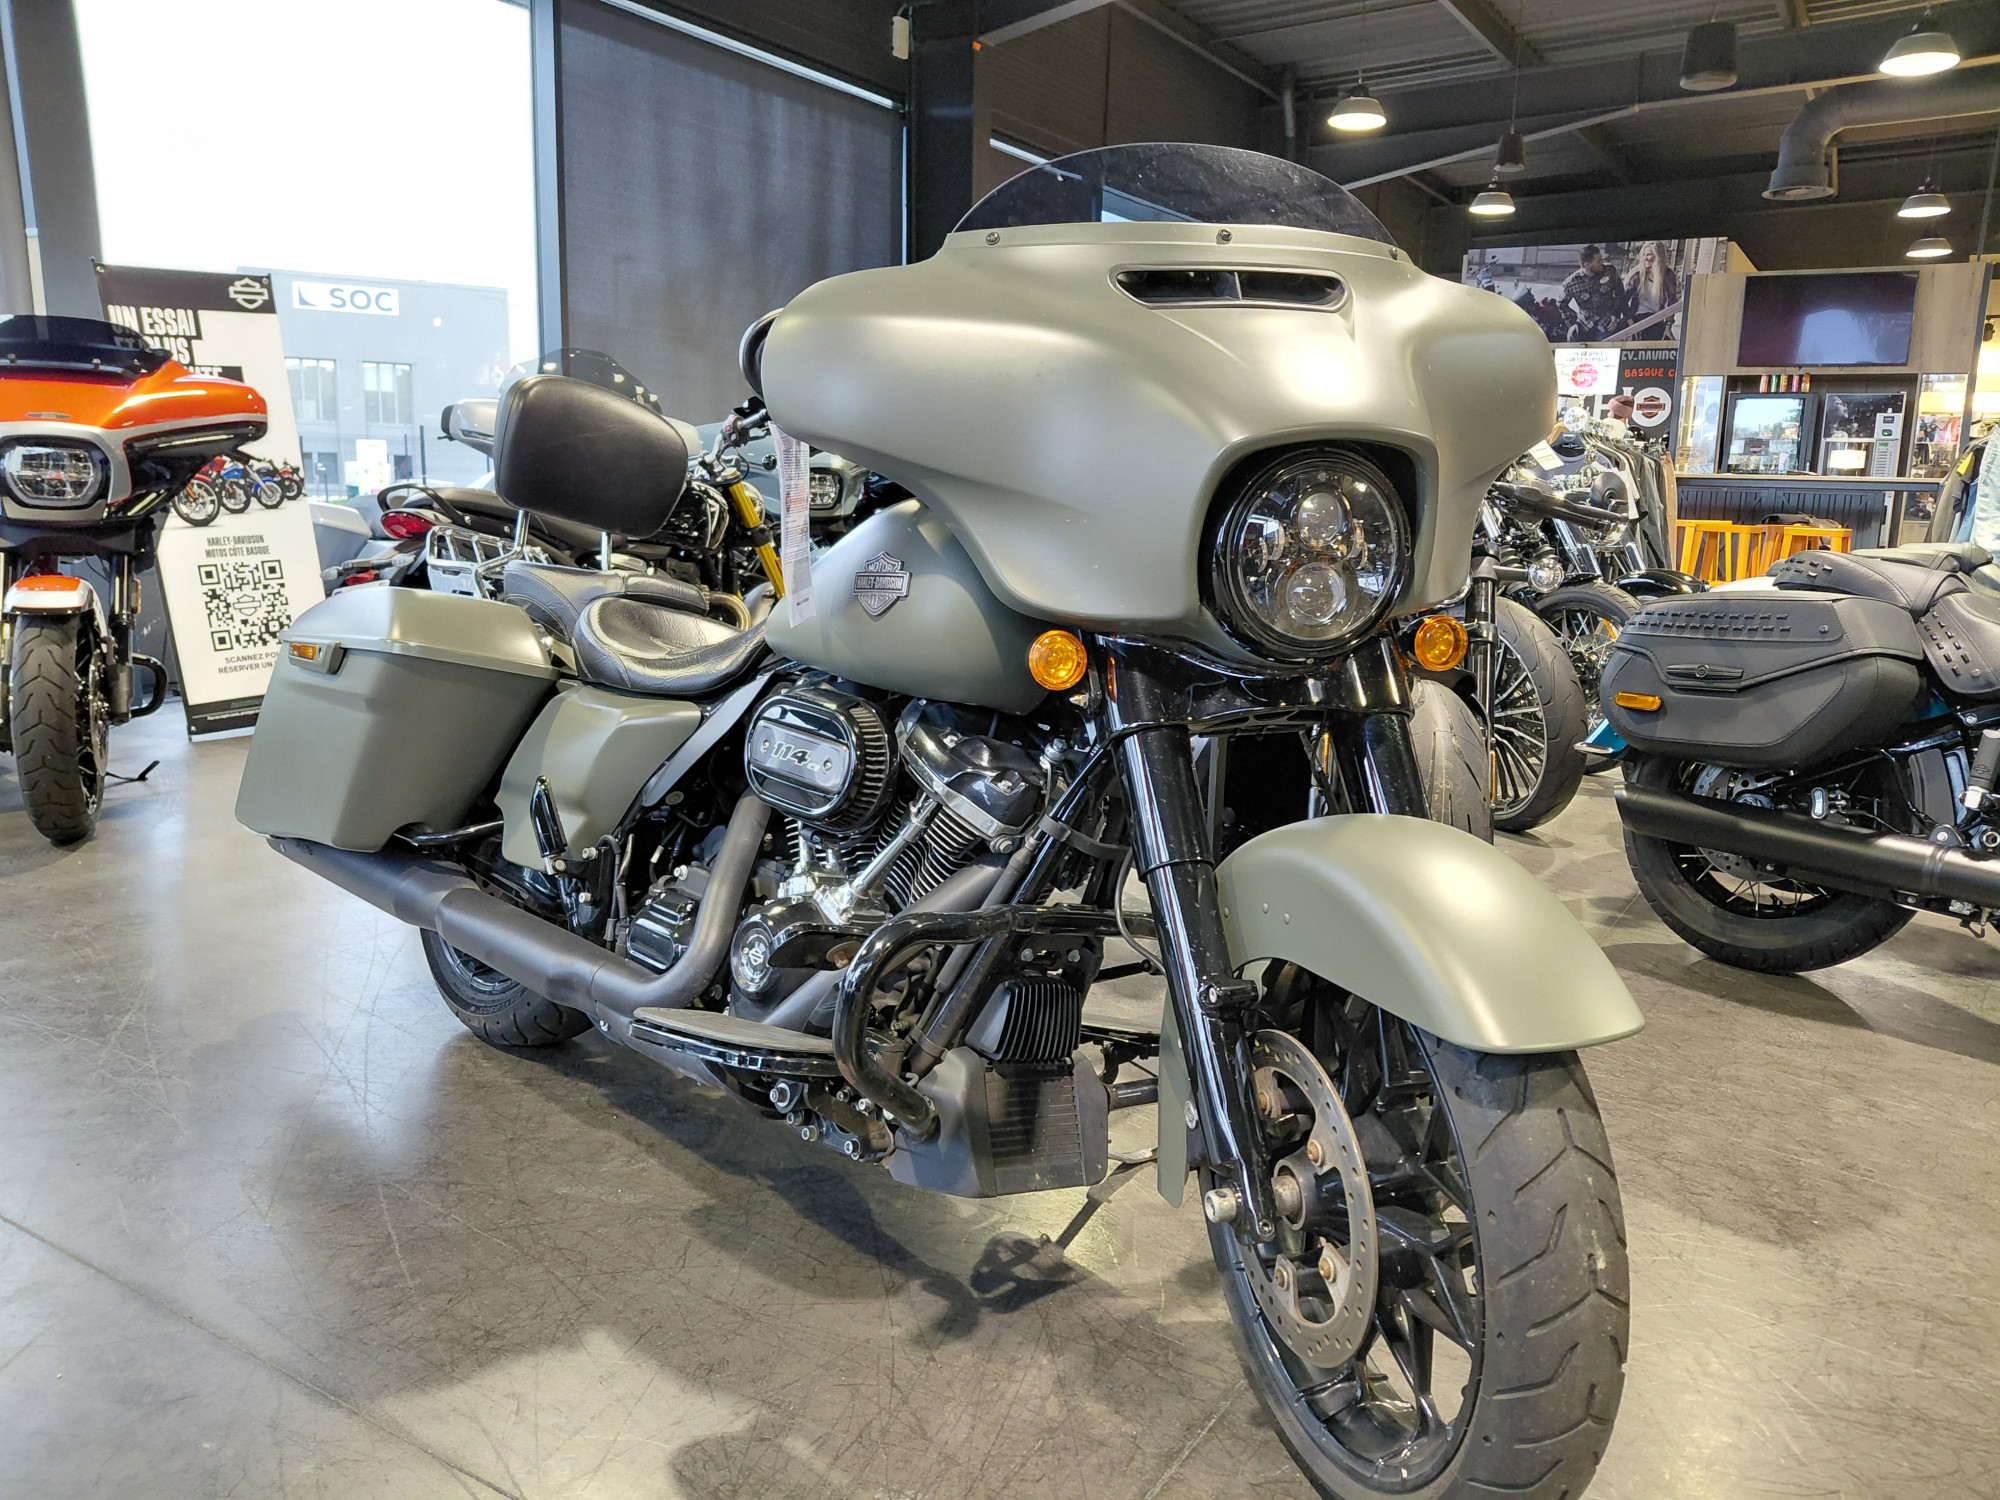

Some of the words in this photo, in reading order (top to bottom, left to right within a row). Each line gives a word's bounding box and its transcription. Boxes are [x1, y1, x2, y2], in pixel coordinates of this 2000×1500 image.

[329, 287, 393, 312] SOC
[140, 306, 197, 336] ESSAI
[1624, 368, 1664, 378] BASQUE
[206, 534, 265, 547] HARLEY-DAVIDSON
[205, 548, 228, 558] MOTOS
[246, 545, 271, 555] BASQUE
[224, 653, 264, 664] SCANNEZ
[218, 662, 260, 674] RÉSERVER
[261, 661, 273, 669] UN
